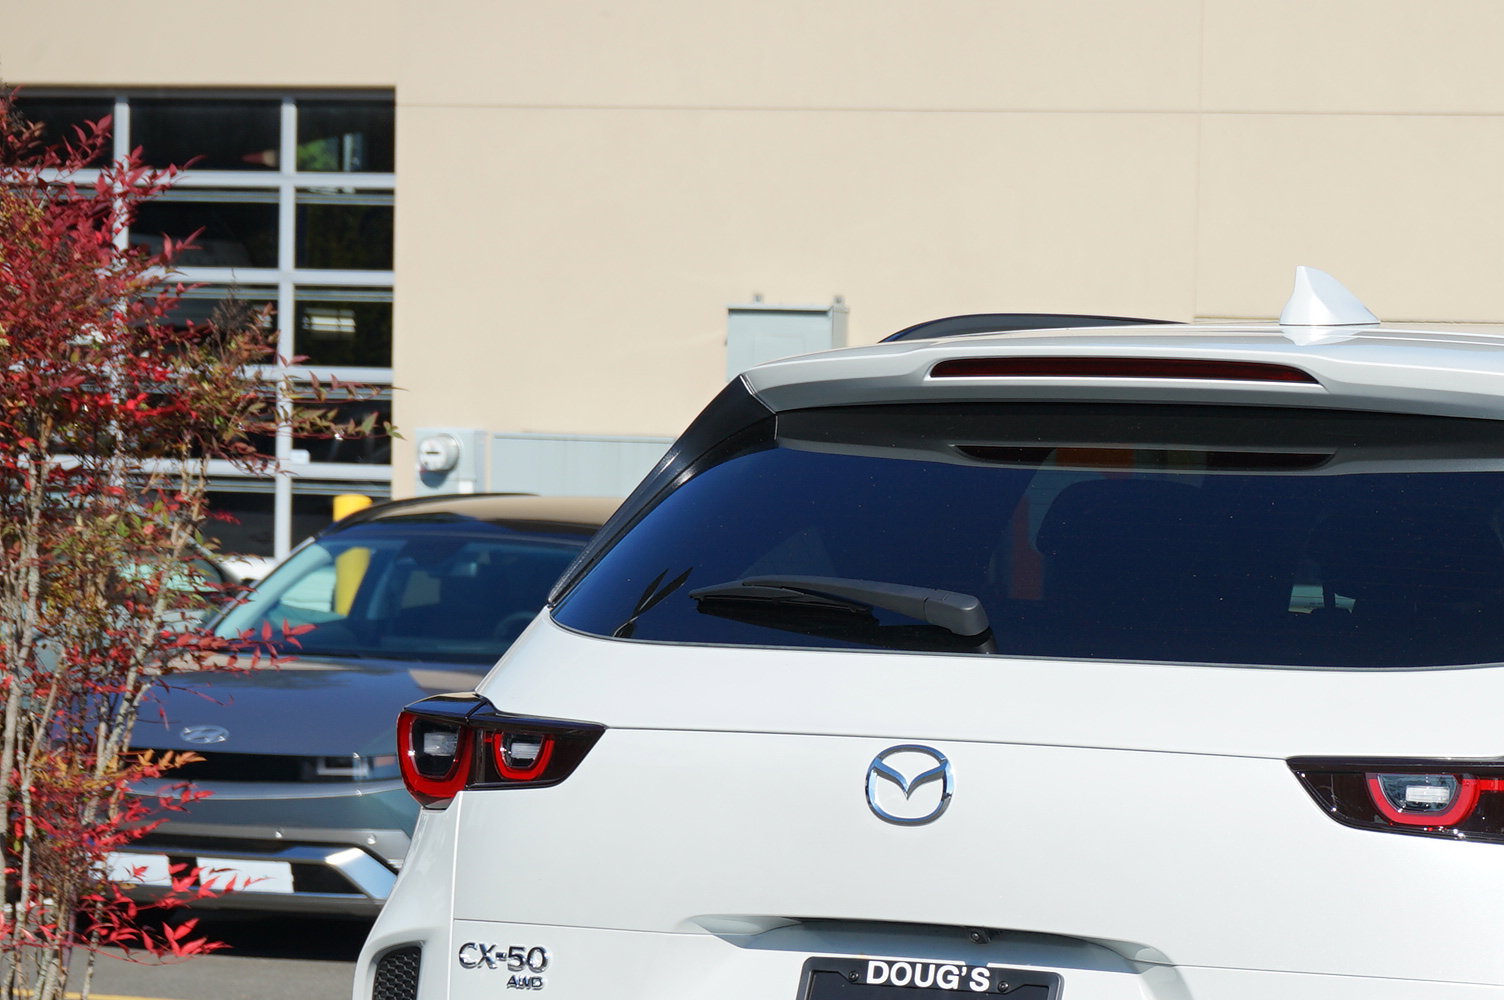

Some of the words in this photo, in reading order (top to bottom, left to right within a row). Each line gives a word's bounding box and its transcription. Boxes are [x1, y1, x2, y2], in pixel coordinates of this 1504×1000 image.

[458, 941, 550, 974] CX-50
[506, 974, 545, 991] AWD
[866, 960, 990, 992] DOUG'S
